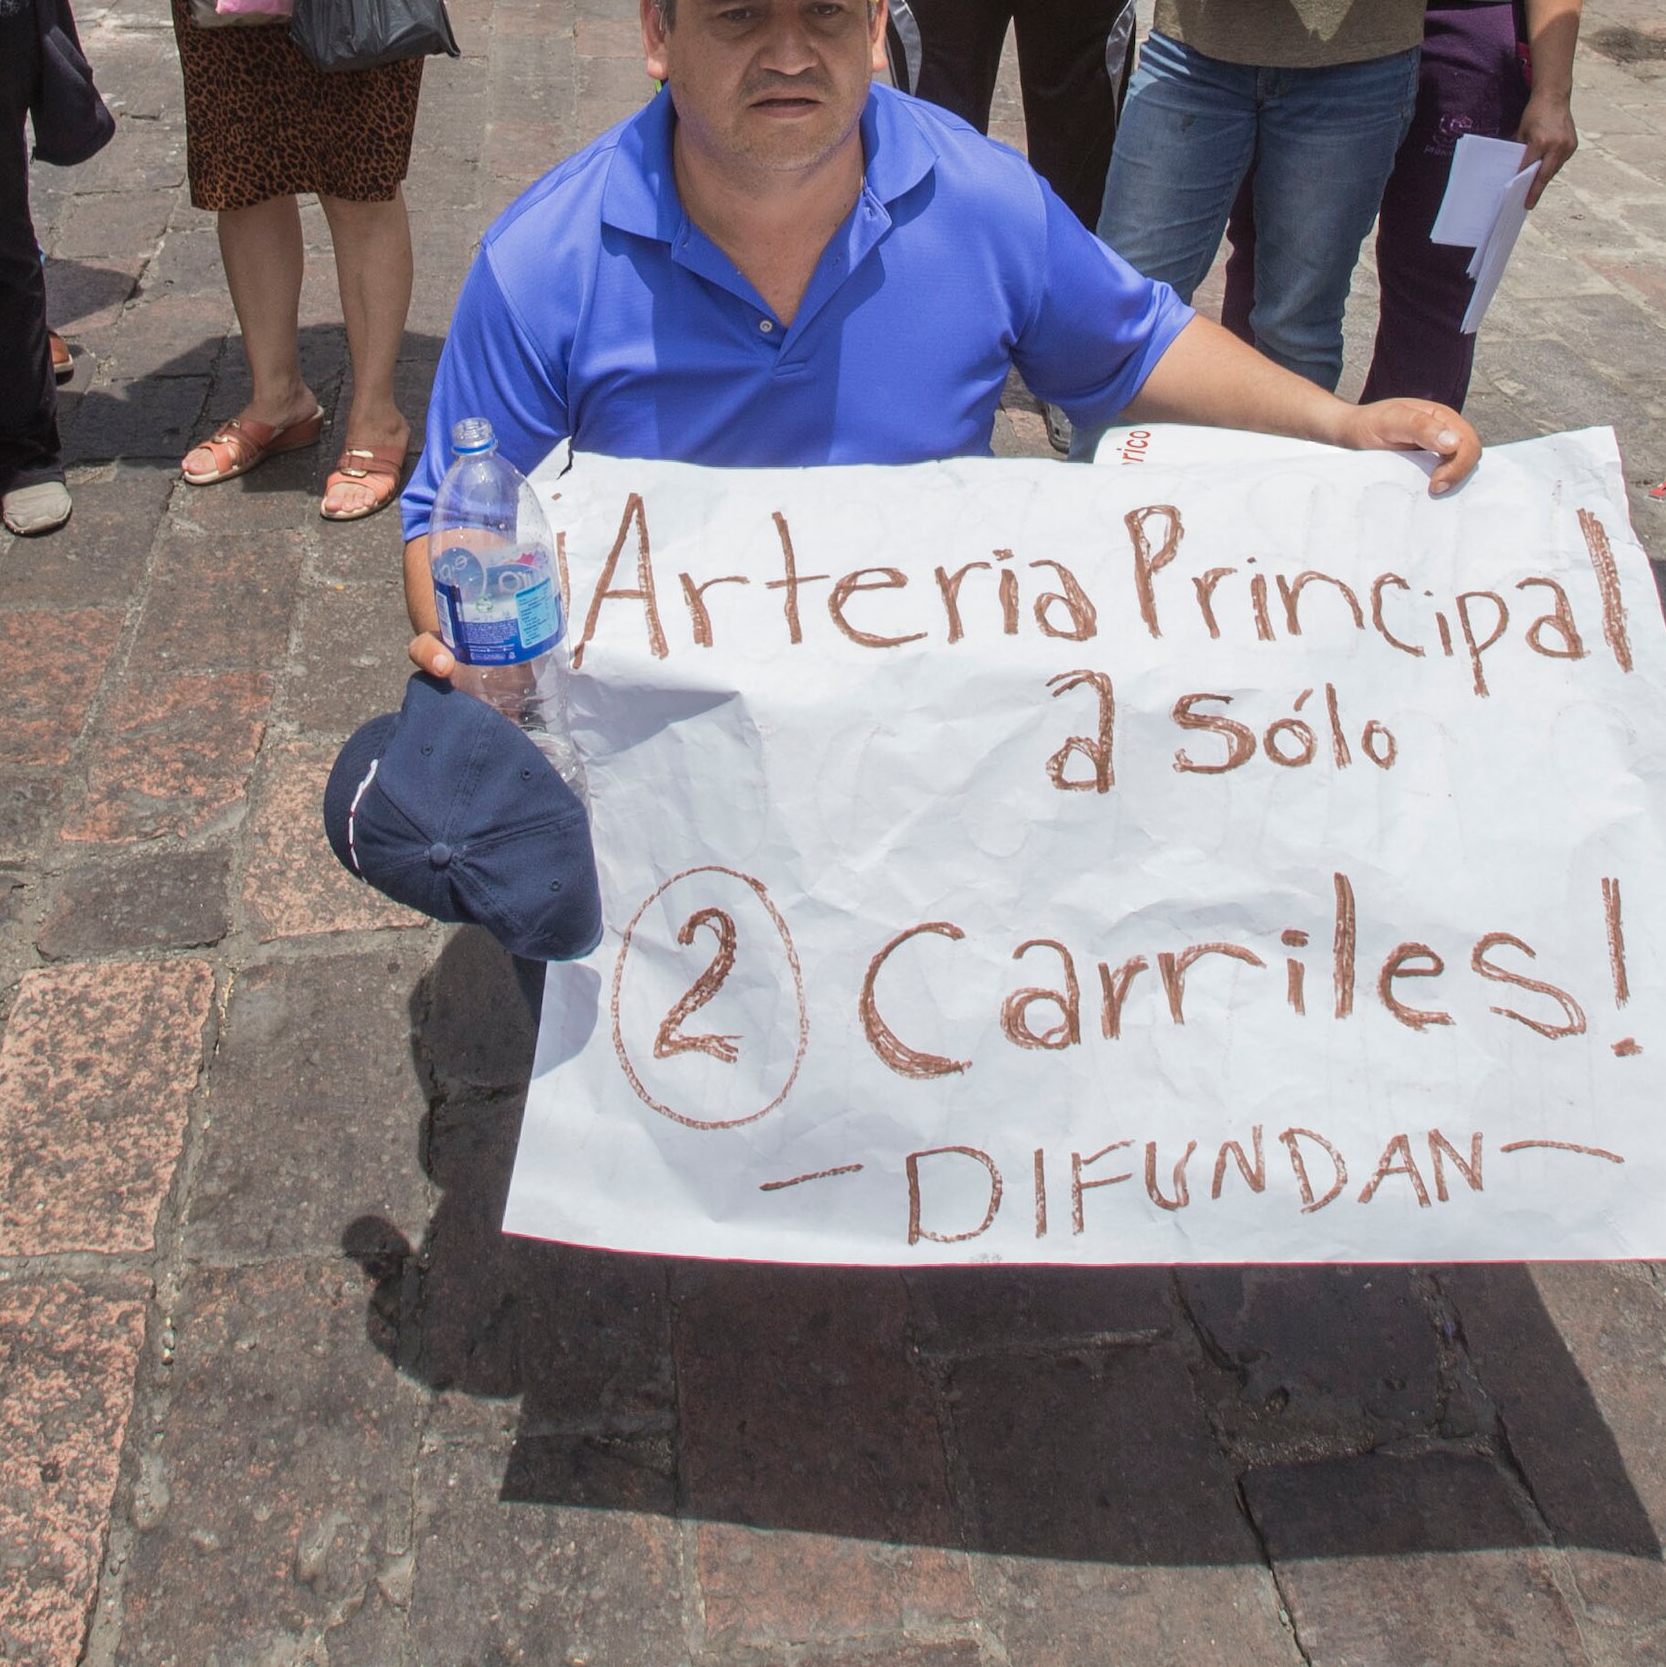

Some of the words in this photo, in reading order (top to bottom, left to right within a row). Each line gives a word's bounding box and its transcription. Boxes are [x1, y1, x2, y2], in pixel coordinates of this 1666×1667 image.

[1043, 668, 1117, 794] a
[652, 907, 740, 1065] 2
[857, 872, 1644, 1081] Carriles!
